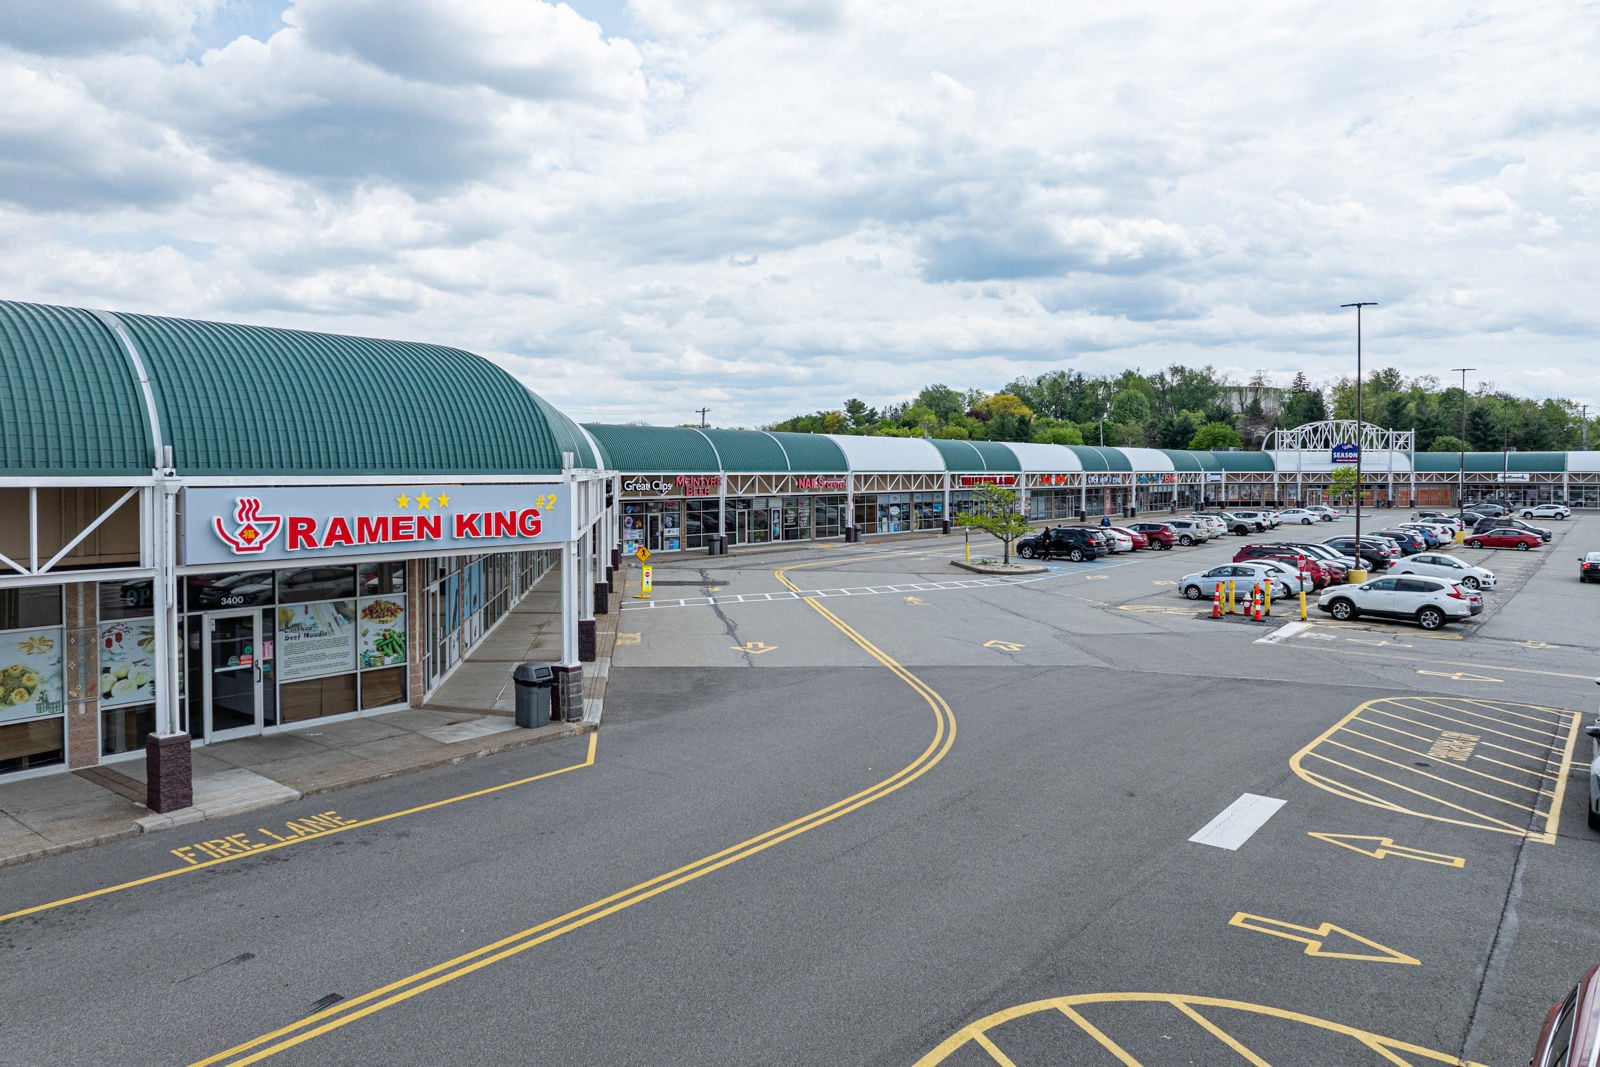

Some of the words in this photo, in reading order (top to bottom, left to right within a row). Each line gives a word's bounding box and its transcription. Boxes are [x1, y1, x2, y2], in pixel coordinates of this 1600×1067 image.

[624, 480, 651, 491] Great
[798, 476, 824, 489] NAILS
[685, 486, 711, 496] BEER
[286, 514, 443, 552] RAMEN
[455, 508, 543, 539] KING
[535, 493, 558, 511] #2
[220, 595, 244, 605] 3400
[170, 832, 266, 865] FIRE
[258, 810, 358, 842] LANE
